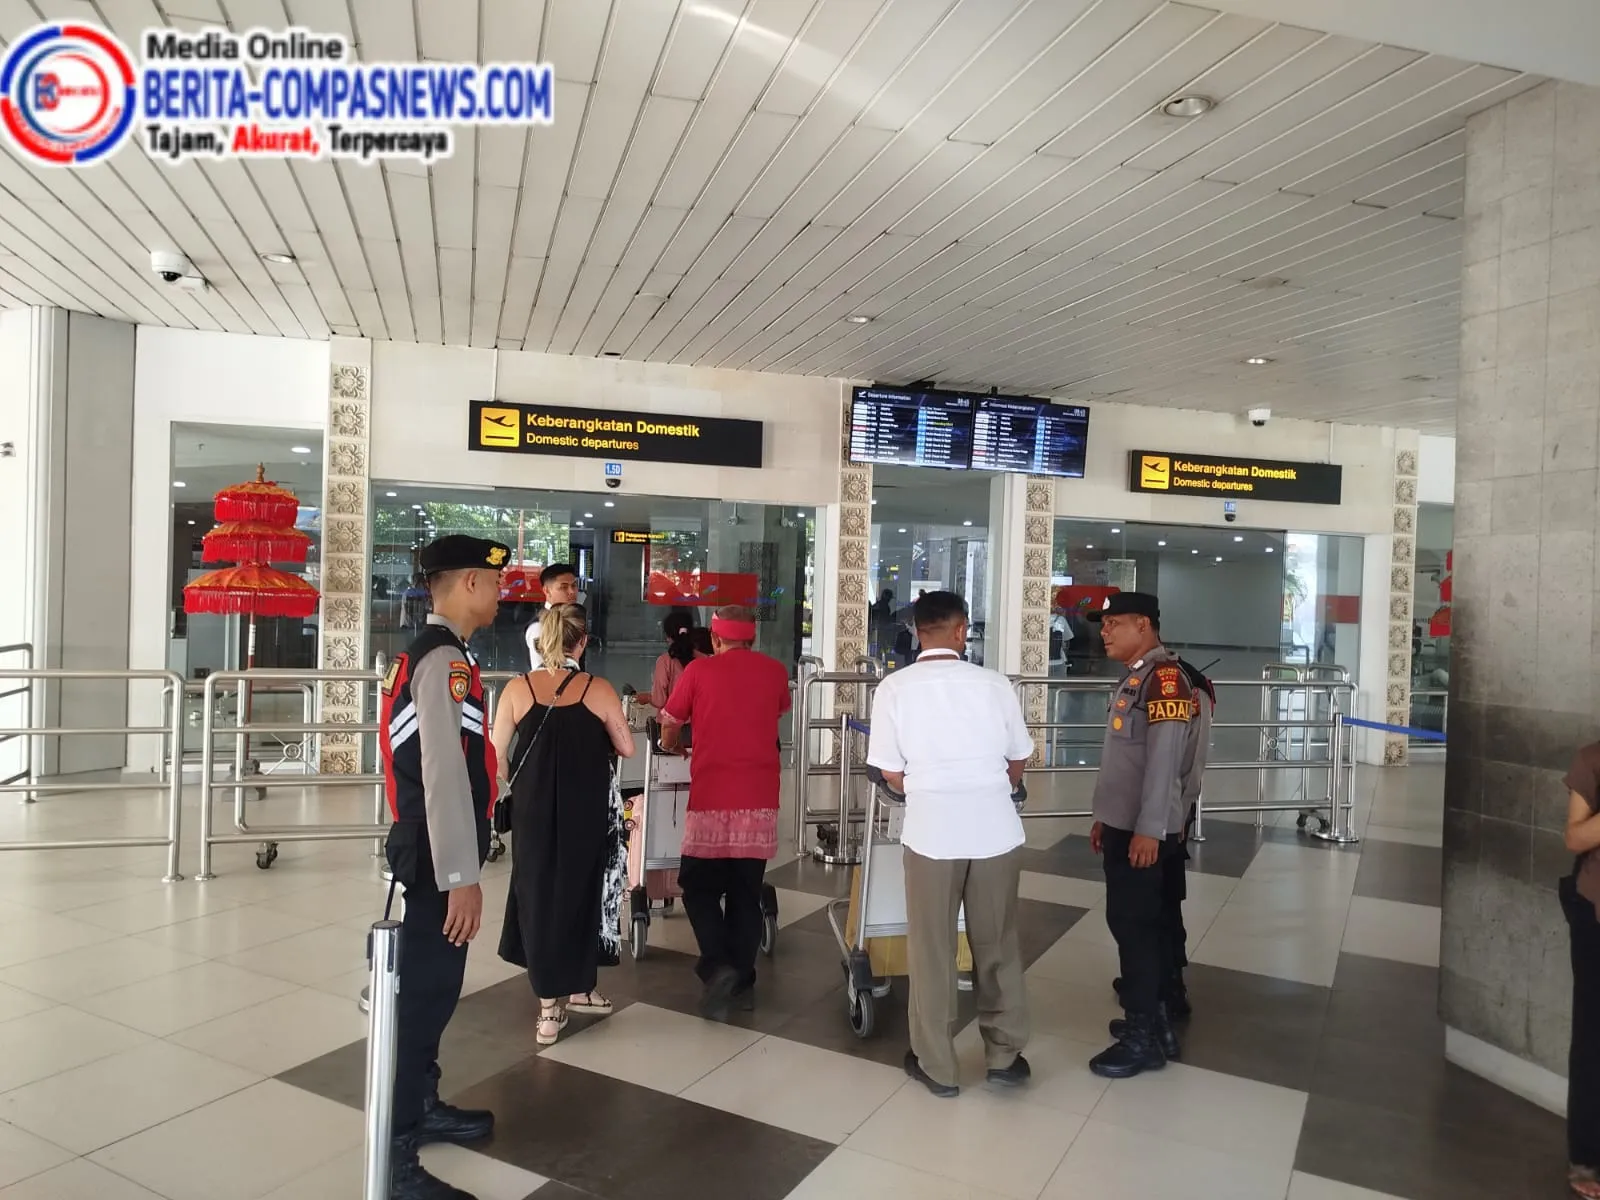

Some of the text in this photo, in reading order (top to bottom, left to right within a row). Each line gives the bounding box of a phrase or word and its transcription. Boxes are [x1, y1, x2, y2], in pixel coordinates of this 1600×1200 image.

[527, 413, 700, 438] Keberangkatan Domestik
[526, 433, 639, 451] Domestic departures
[1174, 460, 1297, 480] Keberangkatan Domestik
[1173, 476, 1253, 492] Domestic departures
[1148, 701, 1190, 719] PADAL
